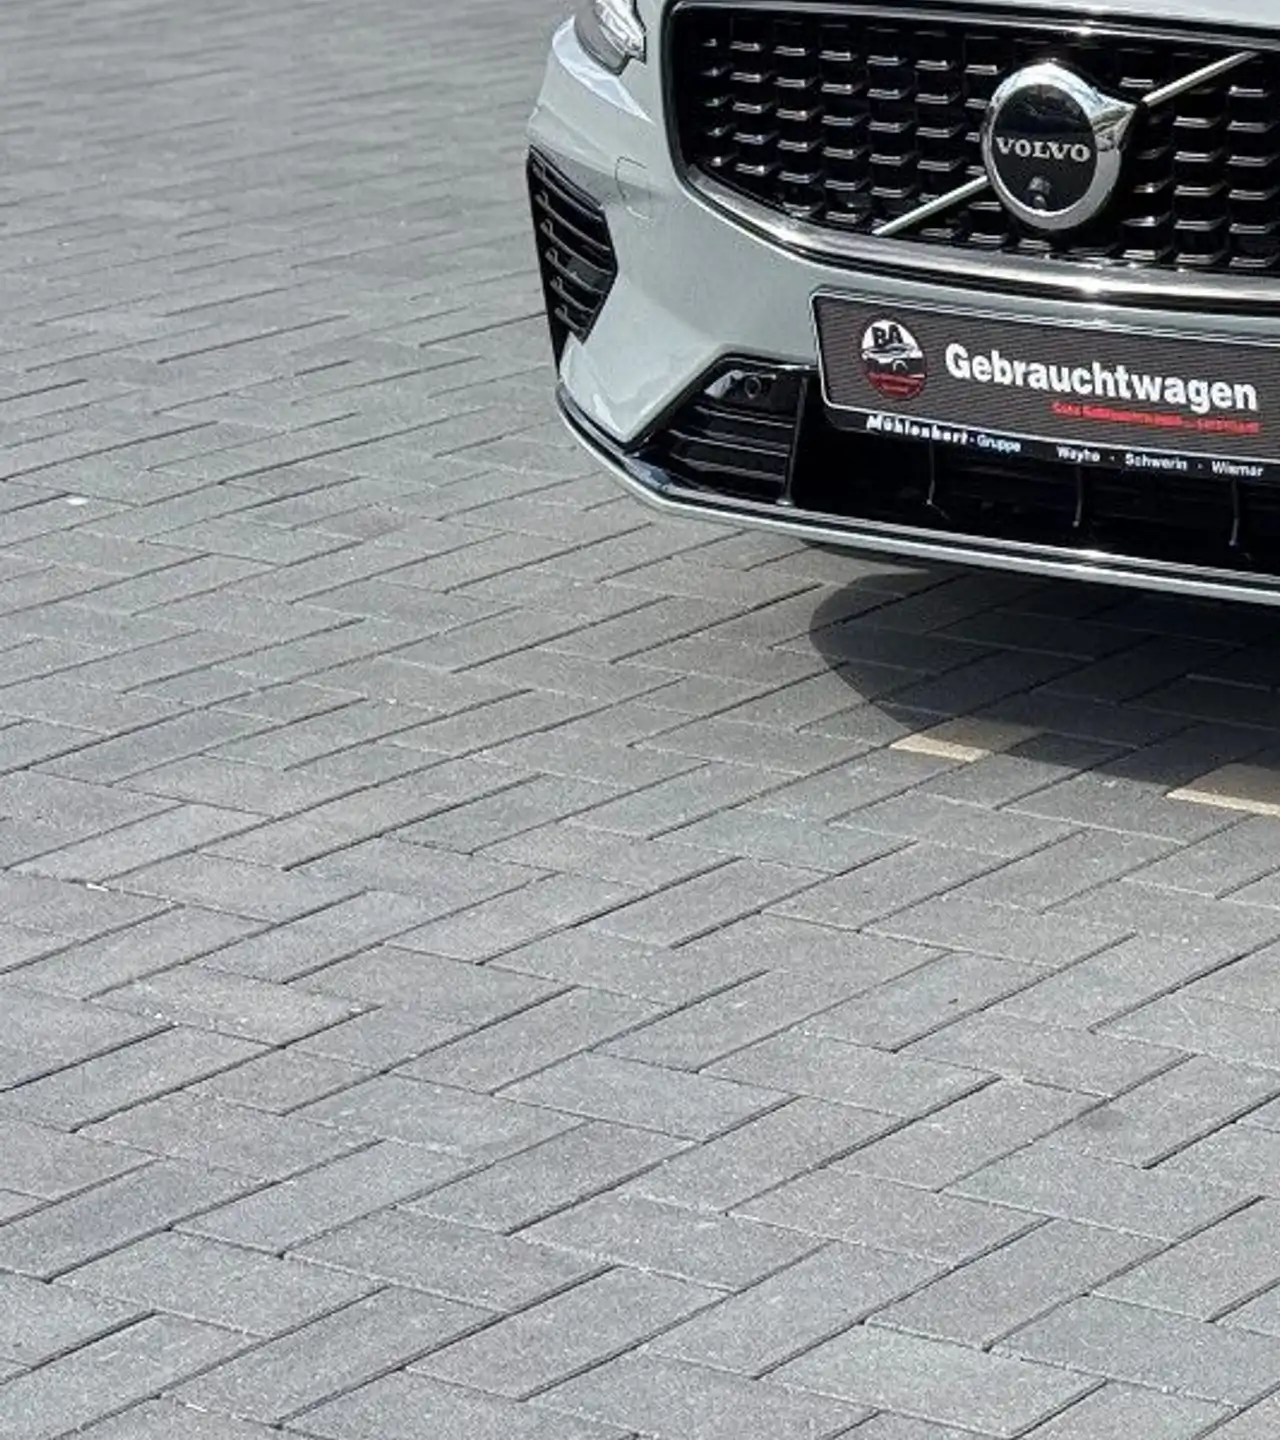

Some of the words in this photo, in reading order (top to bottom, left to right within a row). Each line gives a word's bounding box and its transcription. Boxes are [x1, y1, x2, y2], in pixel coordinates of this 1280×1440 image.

[995, 136, 1091, 163] VOLVO
[945, 343, 1258, 414] Gebrauchtwagen
[1125, 453, 1188, 472] Schwerin
[1212, 461, 1264, 478] Wismar
